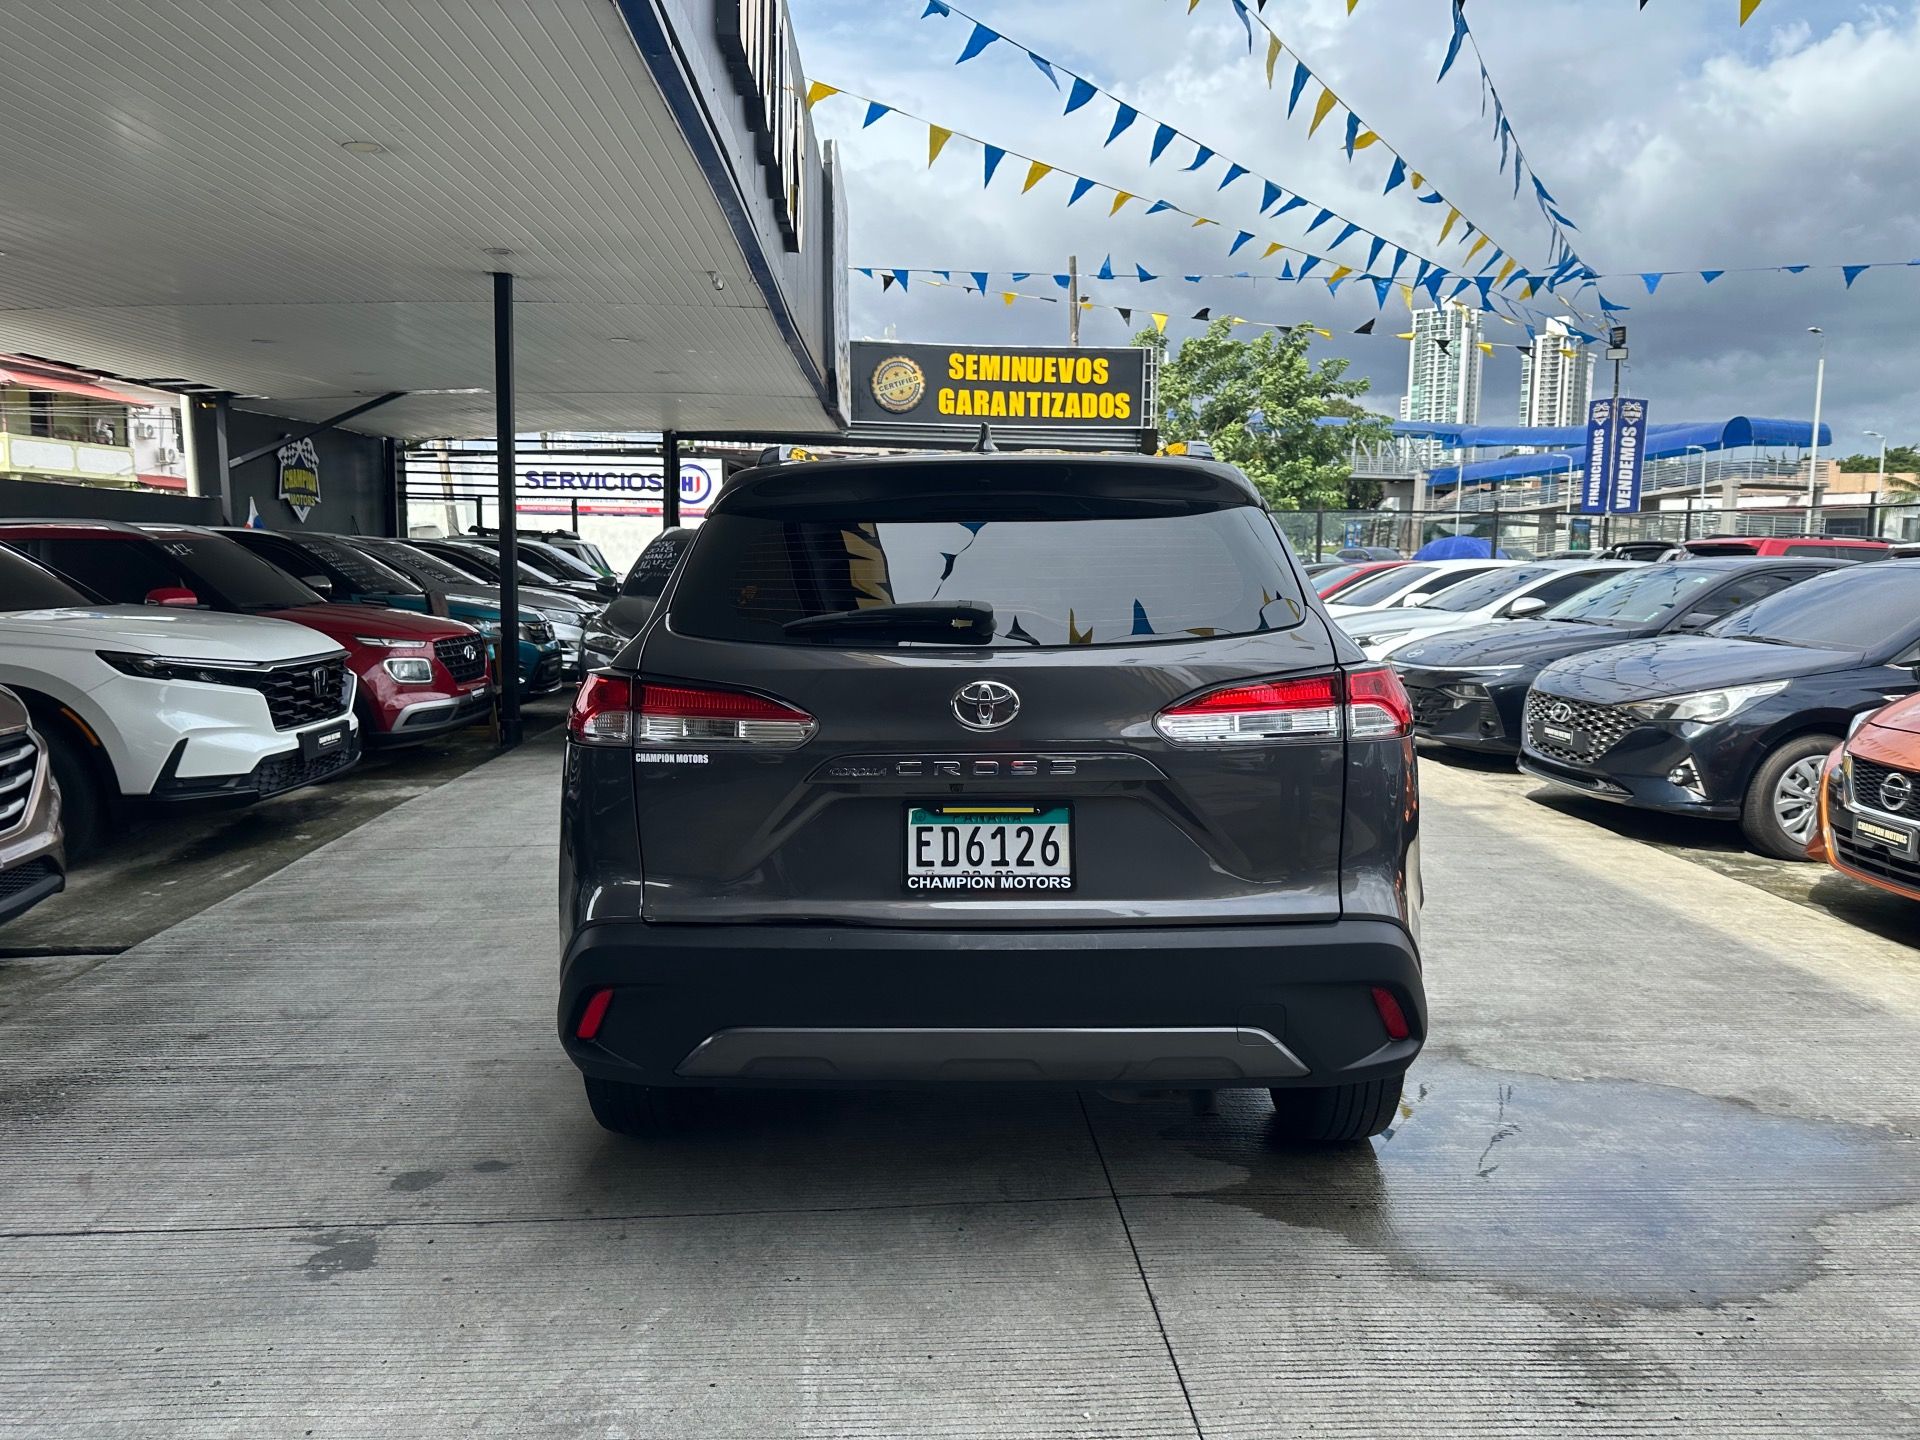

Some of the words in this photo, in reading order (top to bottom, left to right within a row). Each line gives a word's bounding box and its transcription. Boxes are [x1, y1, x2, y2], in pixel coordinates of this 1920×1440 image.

[948, 352, 1109, 385] SEMINUEVOS
[879, 375, 919, 392] CERTIFIED
[938, 388, 1131, 419] GARANTIZADOS
[1587, 428, 1605, 507] FINANCIAMOS
[1615, 426, 1637, 509] VENDEMOS
[524, 470, 663, 492] SERVICIOS
[681, 476, 700, 493] HJ
[289, 494, 316, 507] MOTORS
[635, 753, 675, 763] CHAMPION
[676, 754, 709, 764] MOTORS
[895, 760, 1077, 776] CROSS
[1857, 820, 1884, 838] CHAMPION
[1884, 829, 1908, 845] MOTORS
[915, 825, 1061, 868] ED6126
[907, 876, 996, 890] CHAMPION
[1000, 876, 1072, 890] MOTORS
